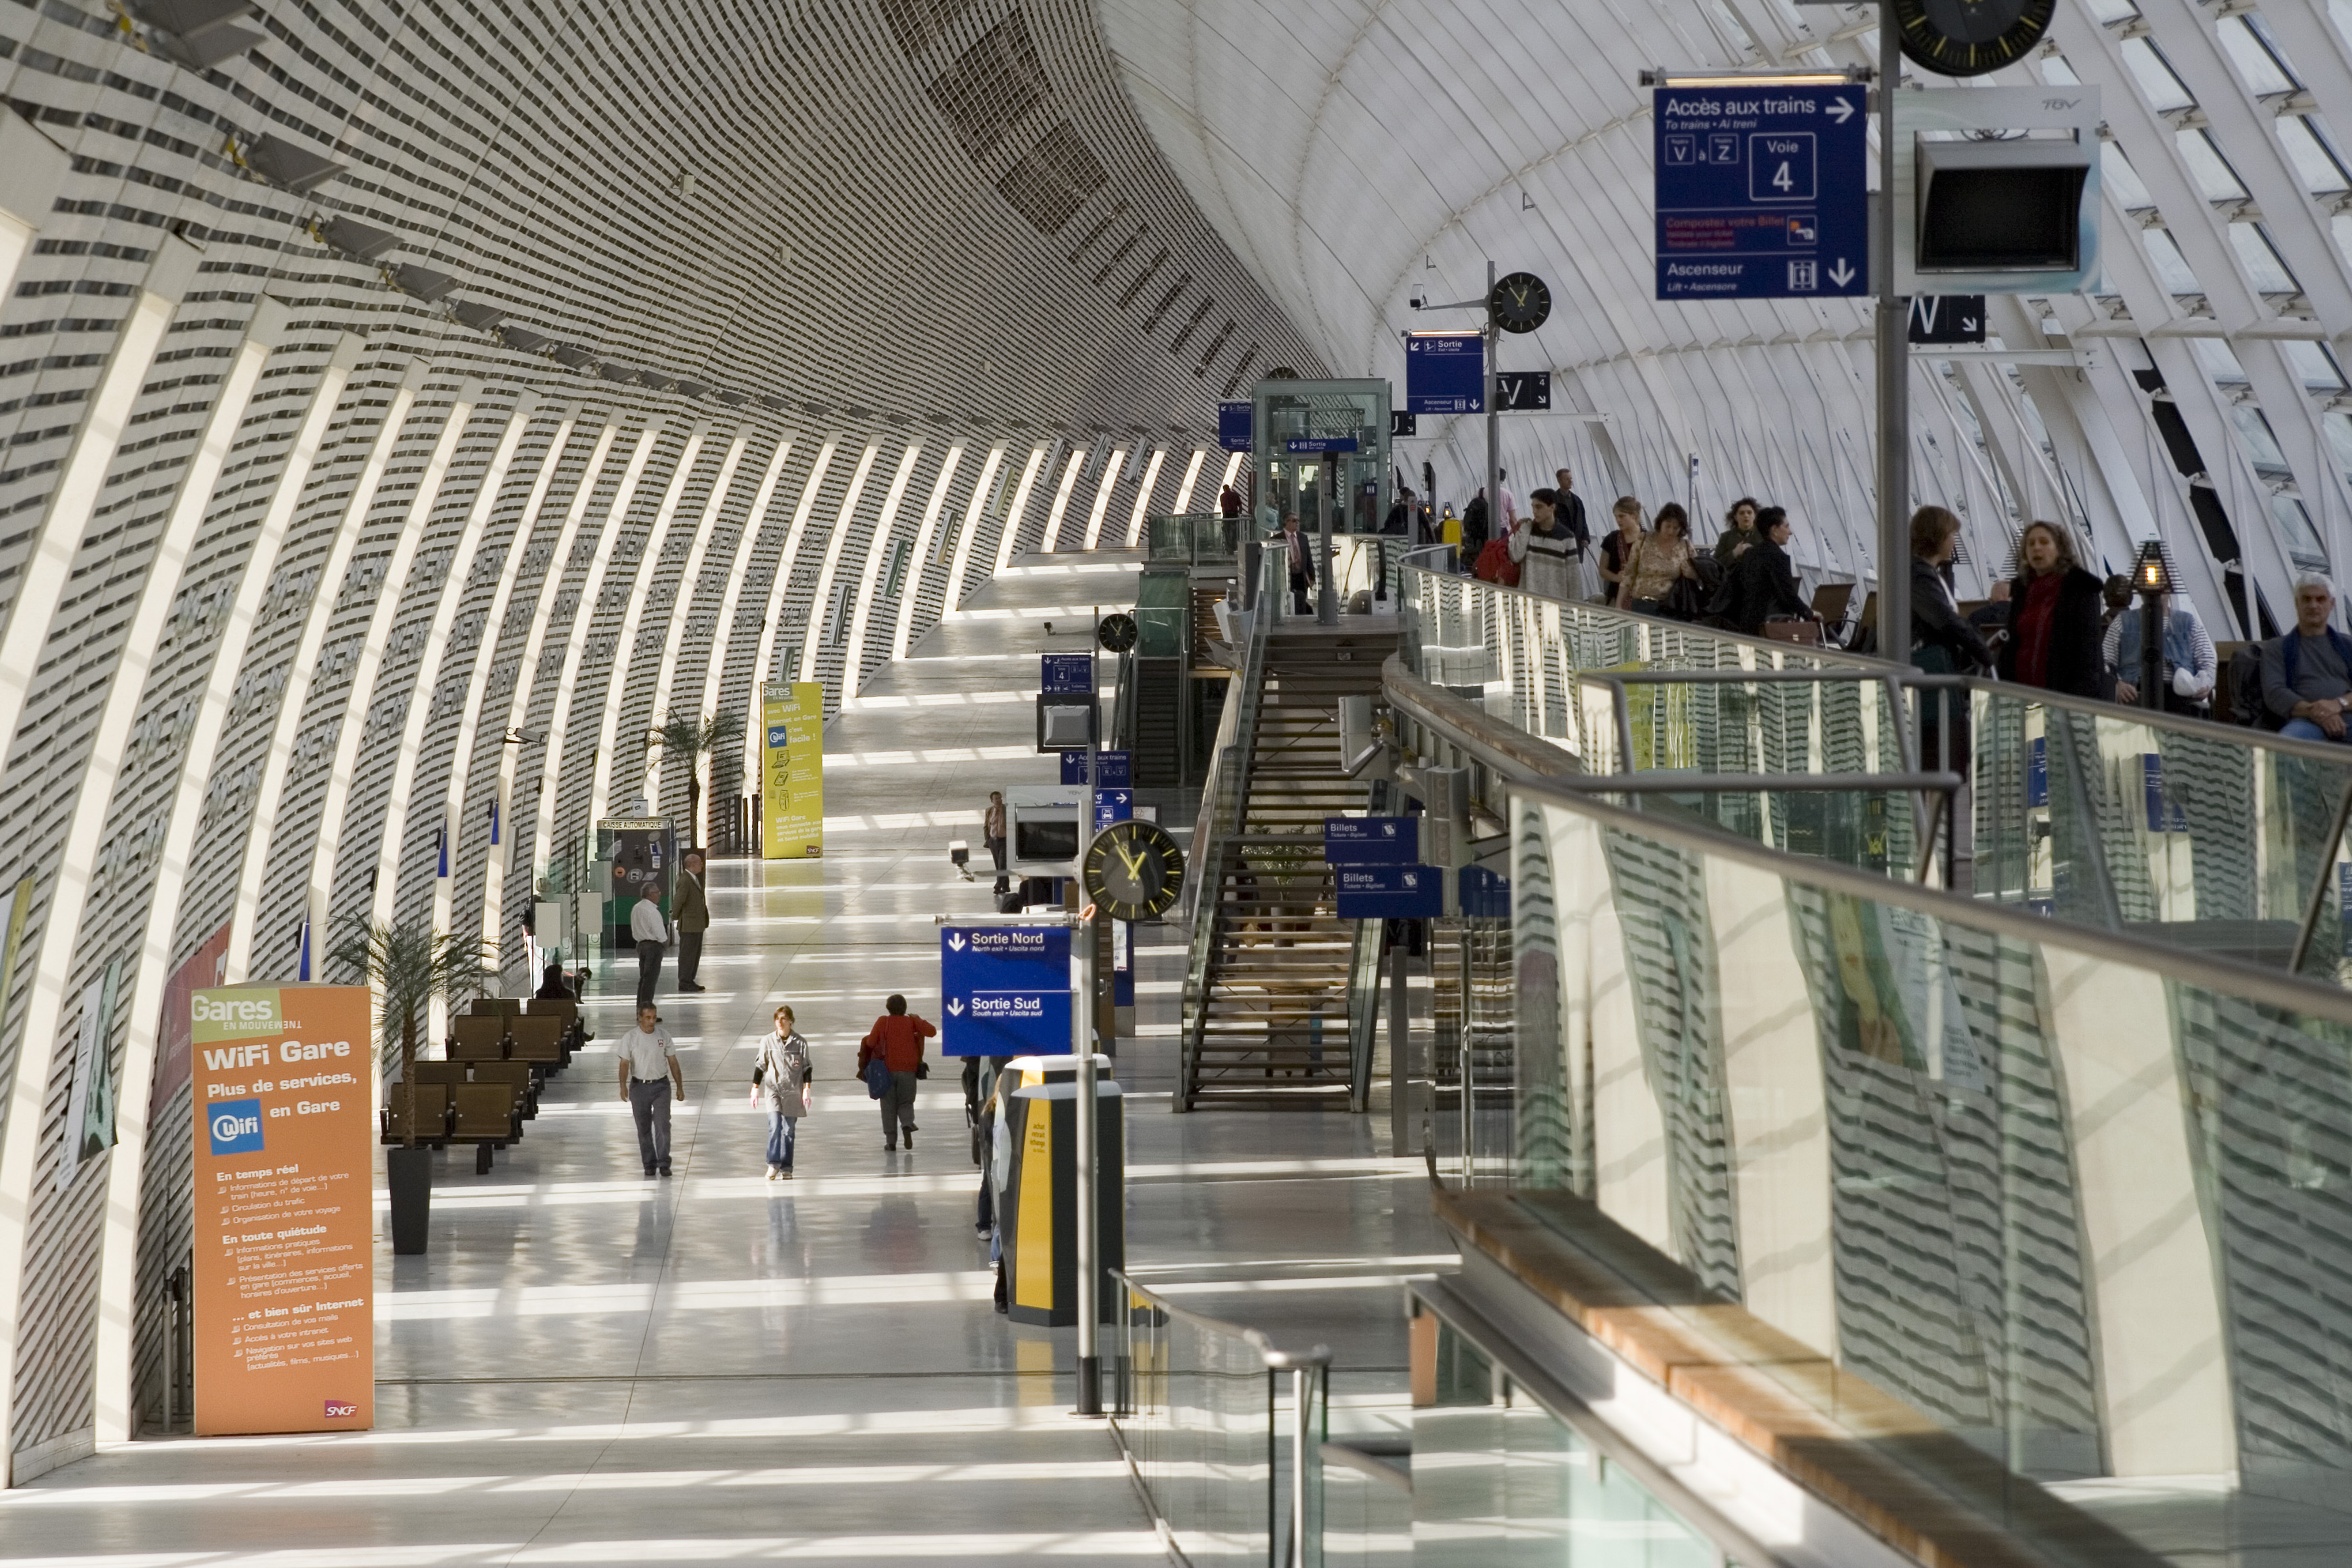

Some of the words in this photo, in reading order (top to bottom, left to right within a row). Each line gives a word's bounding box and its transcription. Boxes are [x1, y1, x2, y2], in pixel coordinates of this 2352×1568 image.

[1665, 97, 1720, 116] Accès
[1725, 102, 1759, 115] aux
[1763, 96, 1816, 114] trains
[2042, 99, 2081, 110] TGV
[1665, 120, 1678, 130] To
[1680, 119, 1710, 129] trains
[1733, 118, 1758, 128] treni
[1674, 146, 1686, 161] V
[1718, 145, 1729, 160] Z
[1767, 140, 1799, 153] Voie
[1773, 161, 1792, 191] 4
[1667, 263, 1743, 276] Ascenseur
[1667, 283, 1681, 292] Lift
[1501, 380, 1522, 404] V
[783, 704, 800, 712] WiFi
[789, 734, 810, 743] facile
[1343, 873, 1373, 882] Billets
[972, 932, 1009, 944] Sortie
[1013, 932, 1043, 944] Nord
[191, 995, 272, 1021] Gares
[972, 997, 1011, 1009] Sortie
[1014, 997, 1040, 1009] Sud
[223, 1022, 236, 1030] EN
[203, 1044, 270, 1071] WiFi
[280, 1041, 350, 1062] Gare
[207, 1083, 246, 1098] Plus
[252, 1079, 274, 1093] de
[280, 1073, 357, 1090] services,
[270, 1106, 291, 1118] en
[297, 1100, 340, 1115] Gare
[216, 1172, 232, 1181] En
[235, 1169, 273, 1179] temps
[276, 1163, 299, 1175] réel
[230, 1181, 277, 1191] Informations
[291, 1176, 316, 1185] départ
[232, 1202, 272, 1211] Circulation
[285, 1198, 306, 1206] trafic
[233, 1213, 280, 1224] Organisation
[293, 1209, 313, 1217] votre
[314, 1206, 341, 1215] voyage
[223, 1235, 238, 1245] En
[242, 1232, 274, 1242] toute
[277, 1224, 327, 1240] quiétude
[236, 1244, 283, 1254] Informations
[285, 1239, 321, 1250] pratiques
[306, 1244, 353, 1254] informations
[240, 1272, 287, 1283] Présentation
[305, 1267, 336, 1275] services
[338, 1263, 363, 1271] offerts
[252, 1281, 270, 1290] gare
[240, 1290, 272, 1298] horaires
[248, 1310, 261, 1319] et
[265, 1307, 289, 1318] bien
[293, 1303, 312, 1314] sûr
[316, 1298, 364, 1311] Internet
[244, 1320, 290, 1331] Consultation
[318, 1313, 338, 1322] mails
[245, 1334, 269, 1343] Accès
[278, 1331, 297, 1339] votre
[299, 1327, 329, 1336] intranet
[246, 1345, 285, 1354] Navigation
[336, 1335, 353, 1343] web
[246, 1352, 278, 1363] préférés
[326, 1405, 357, 1417] SNCF
